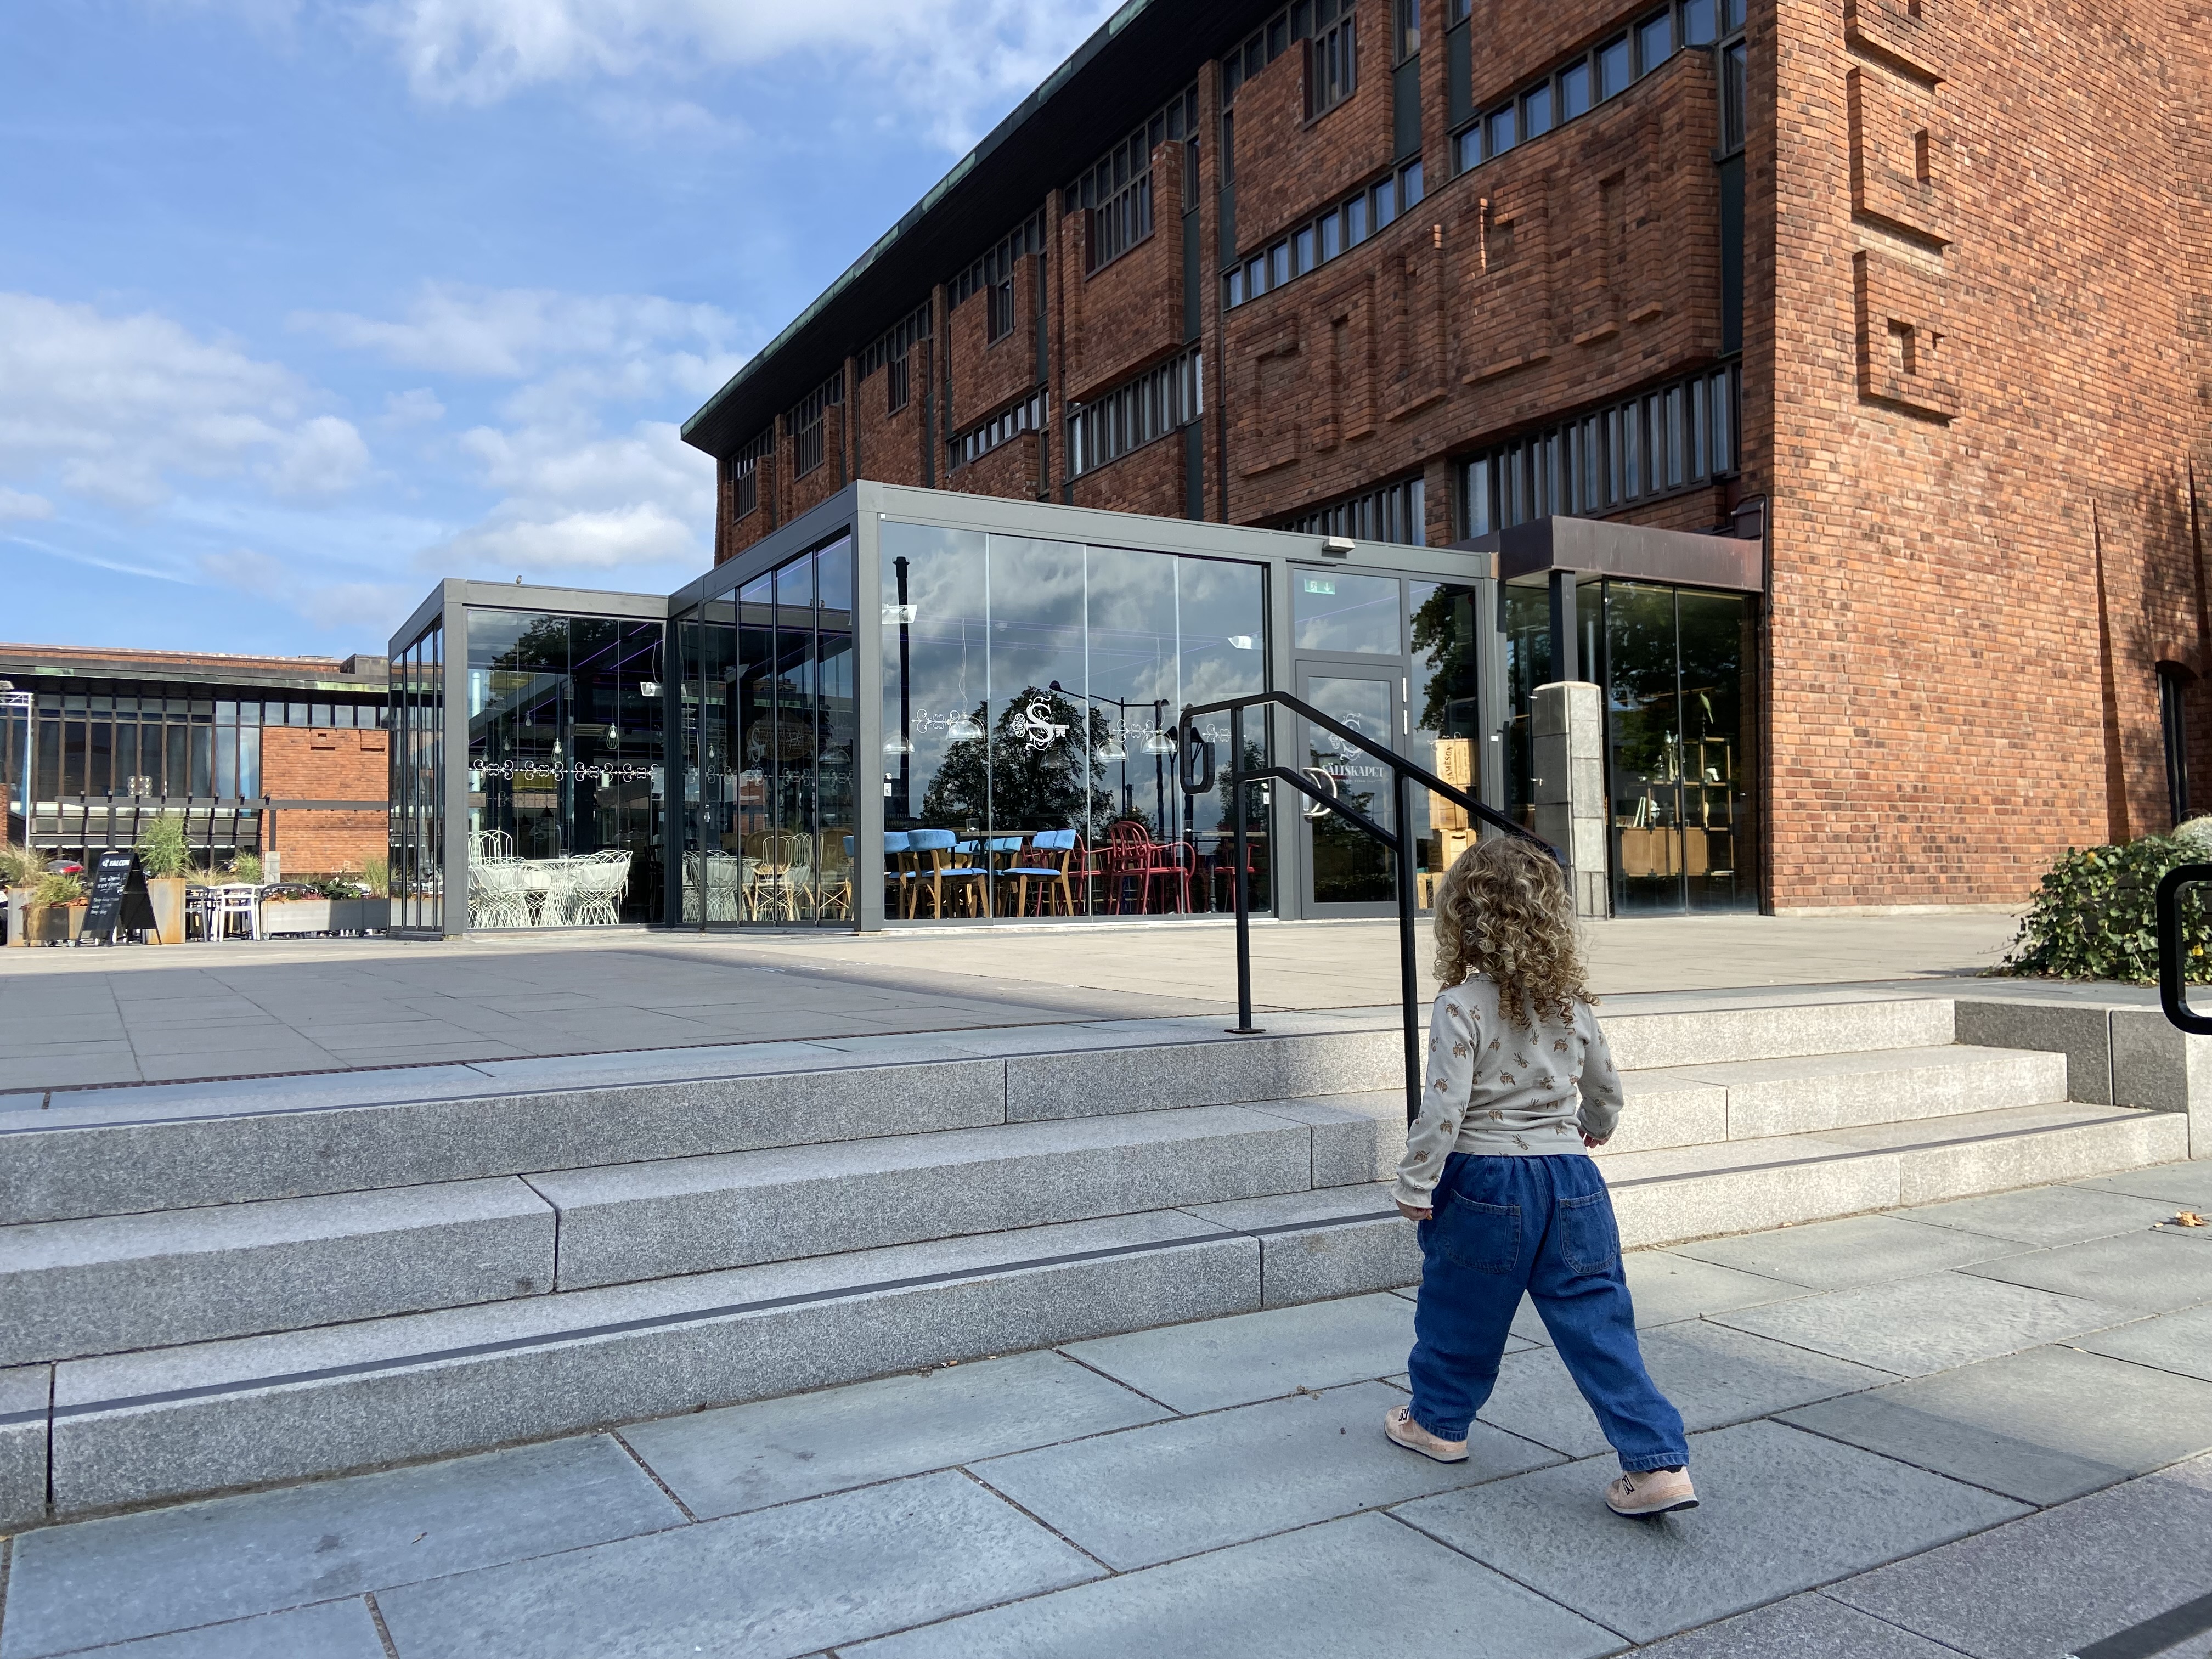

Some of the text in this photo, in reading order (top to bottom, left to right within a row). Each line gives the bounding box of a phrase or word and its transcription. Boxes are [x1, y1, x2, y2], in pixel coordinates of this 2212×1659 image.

[1322, 762, 1385, 777] SÄLLSKAPET
[1444, 746, 1455, 781] JAMESON
[1398, 1408, 1409, 1421] N
[1621, 1474, 1635, 1496] N
